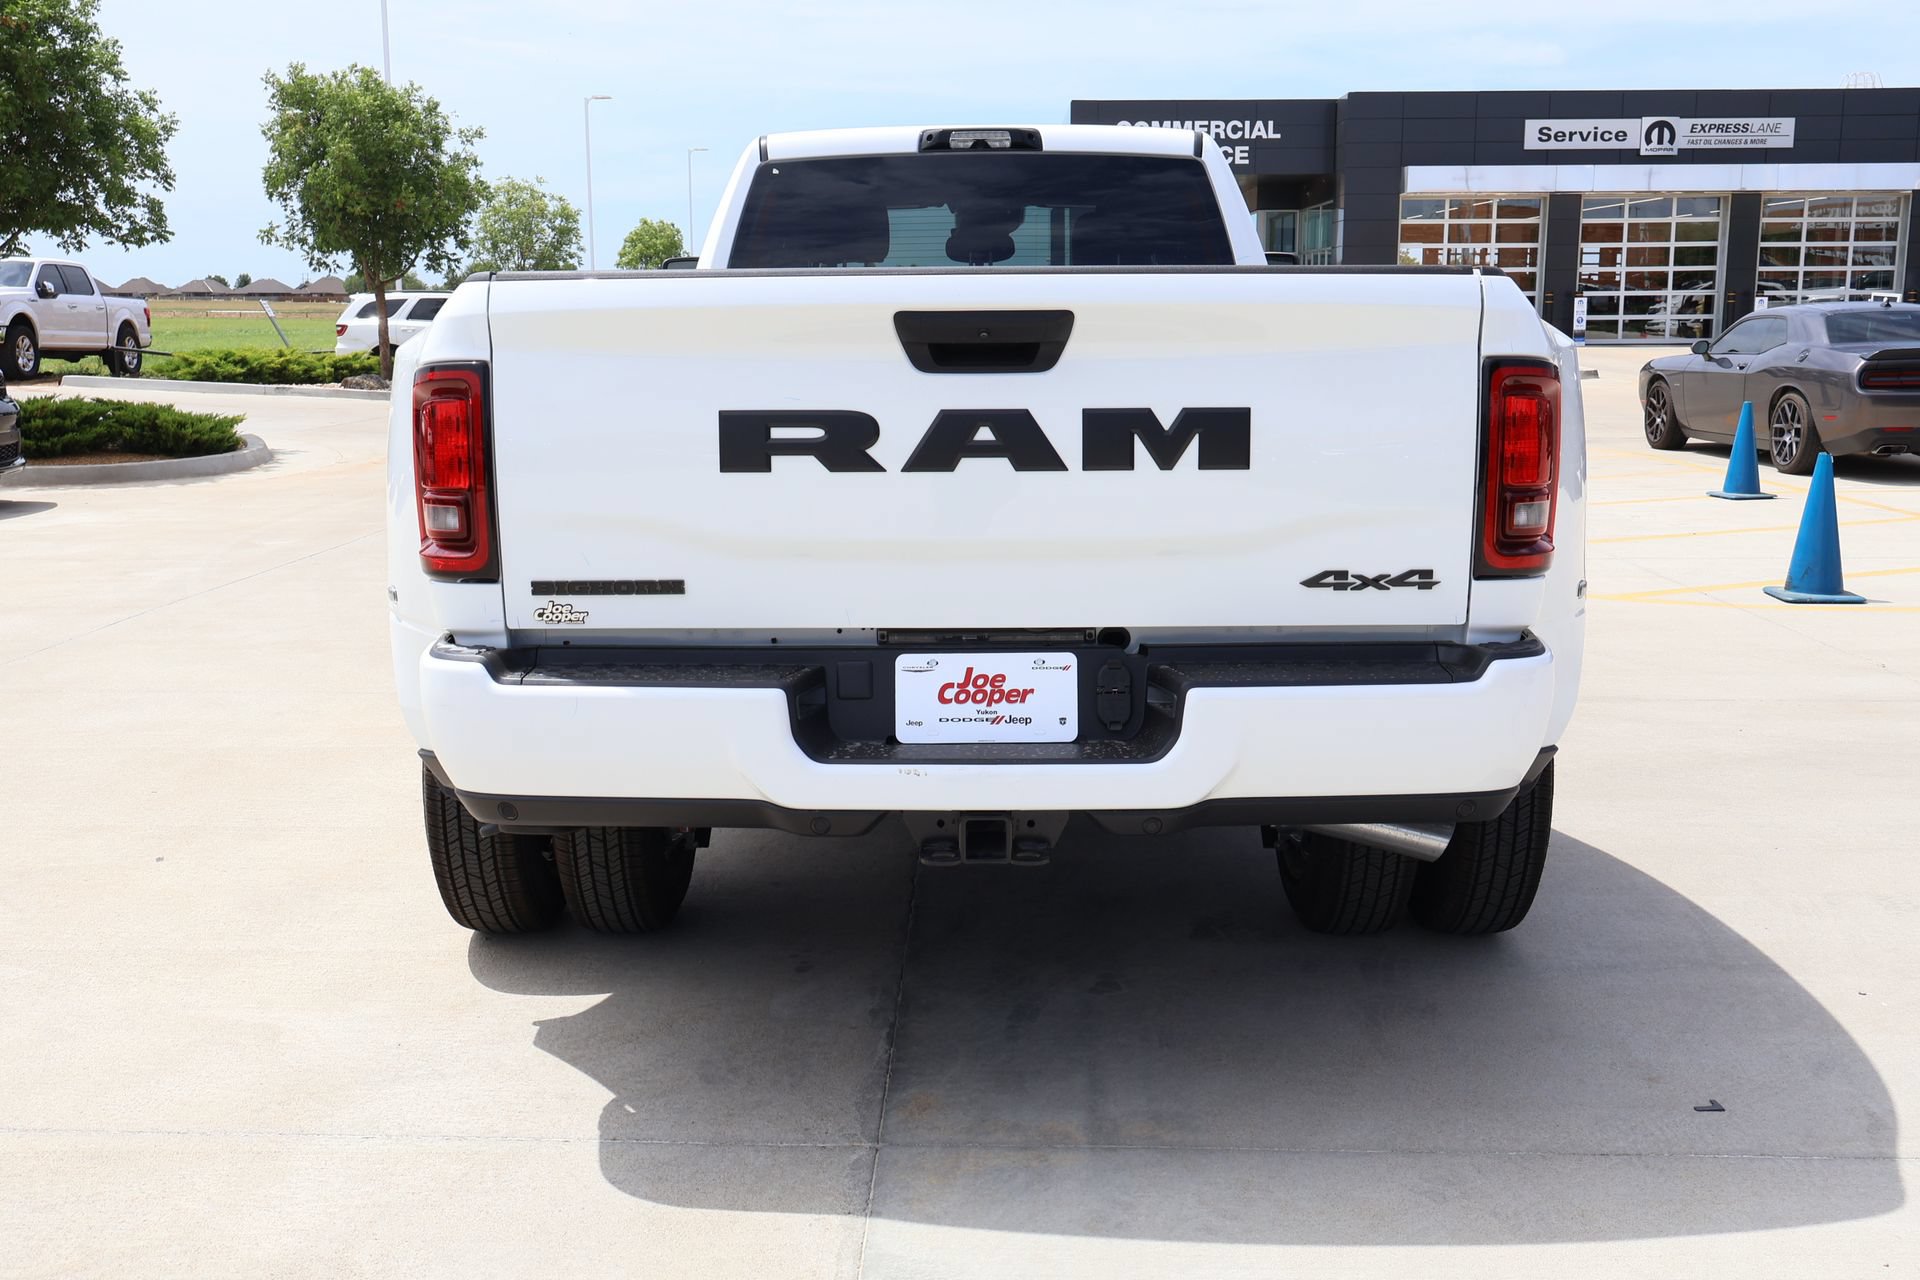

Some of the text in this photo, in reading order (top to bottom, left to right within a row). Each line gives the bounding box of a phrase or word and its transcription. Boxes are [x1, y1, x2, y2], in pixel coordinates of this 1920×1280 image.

[1116, 120, 1281, 139] ERCIAL
[1537, 126, 1628, 143] Service
[718, 407, 1251, 473] RAM
[1299, 569, 1441, 591] 4x4
[534, 608, 588, 622] Cooper
[543, 600, 573, 613] Joe
[956, 667, 1007, 689] Joe
[937, 682, 1035, 707] Cooper
[905, 719, 923, 727] Jeep
[1005, 715, 1032, 726] Jeep
